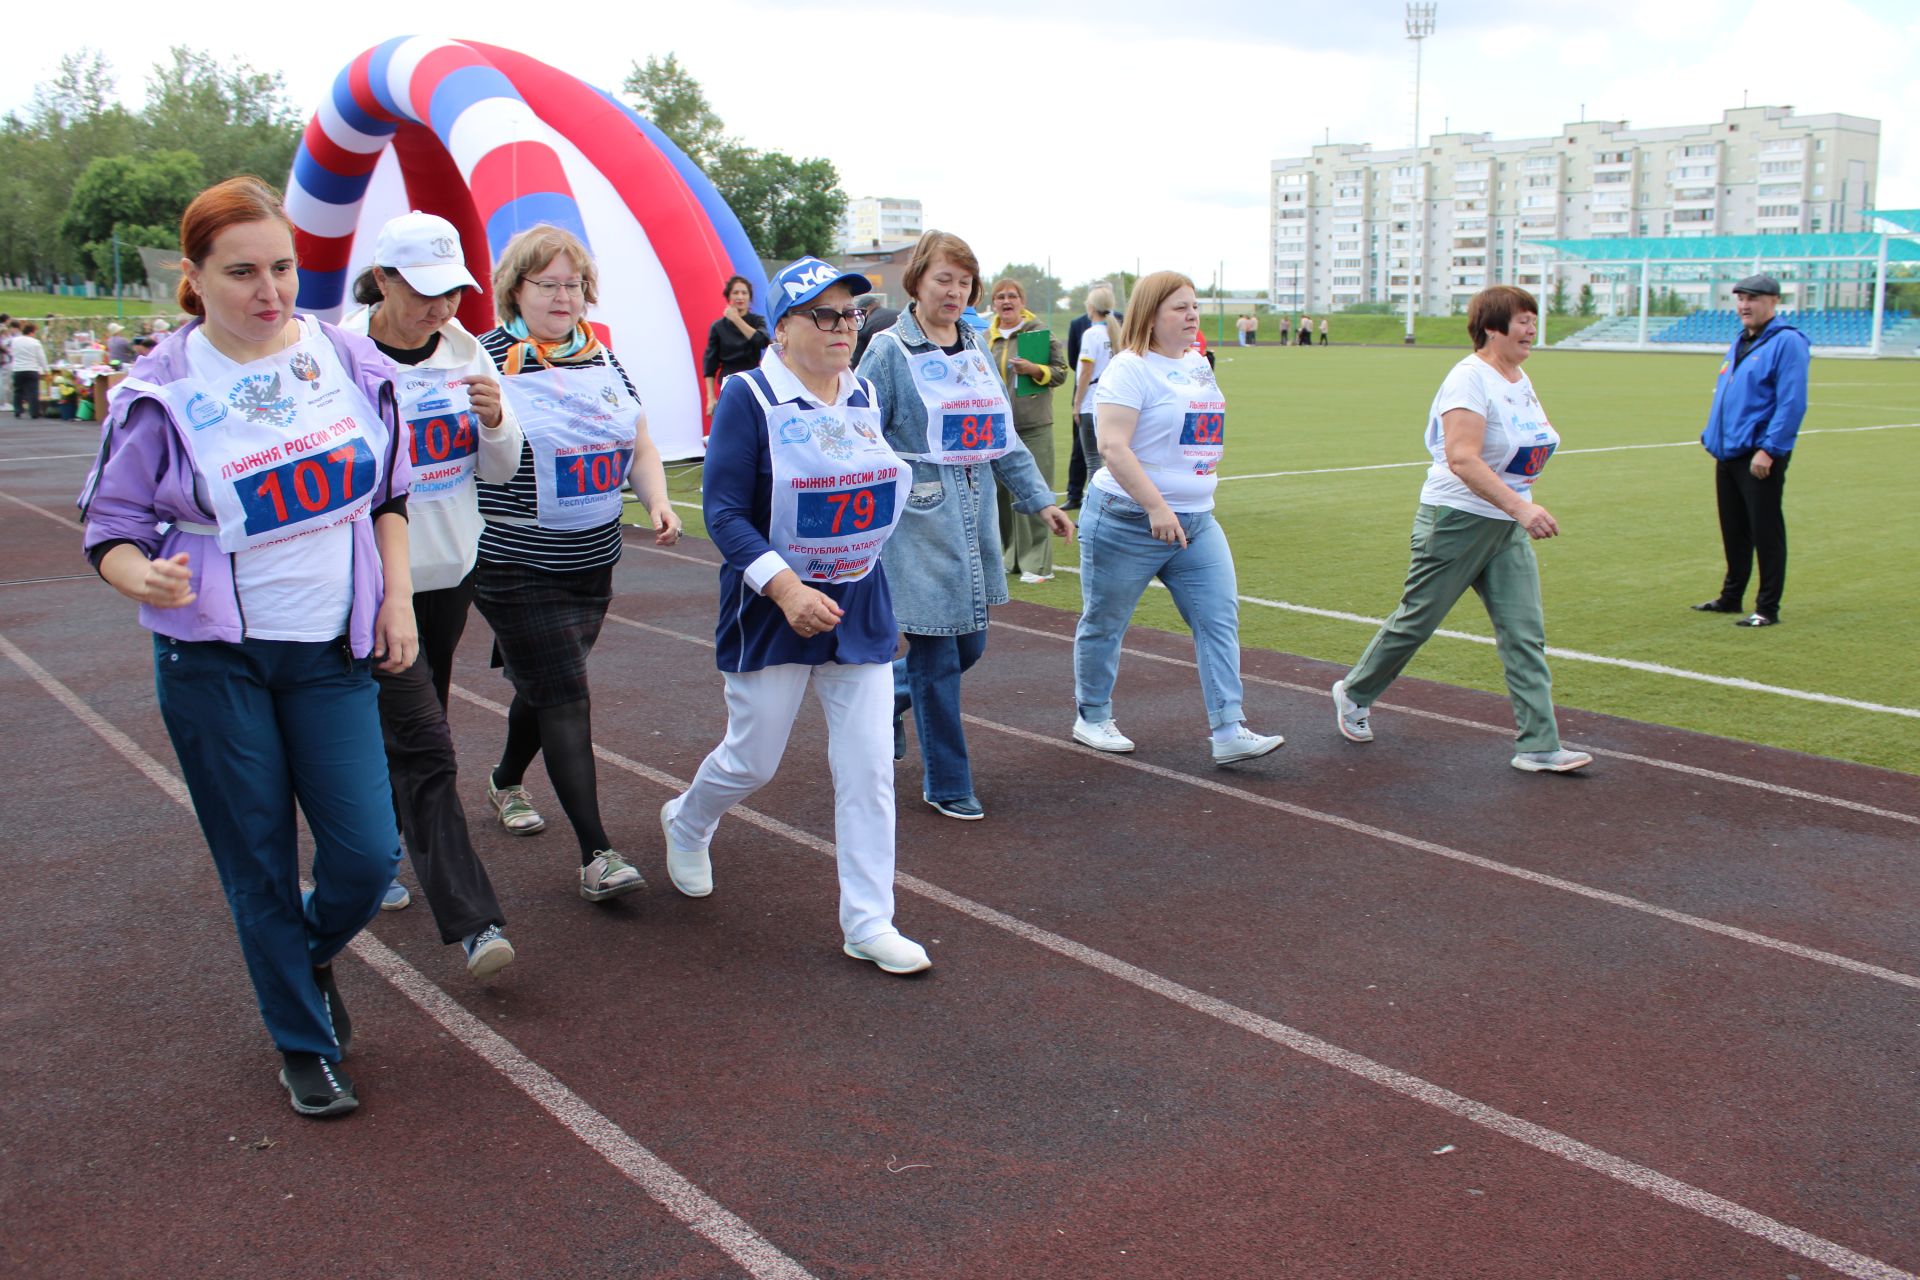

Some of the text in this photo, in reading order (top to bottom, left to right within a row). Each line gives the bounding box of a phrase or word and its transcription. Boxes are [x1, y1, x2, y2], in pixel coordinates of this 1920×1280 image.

[228, 374, 271, 401] ЛЫЖНЯ
[941, 399, 970, 410] ЛЫЖНЯ
[407, 413, 474, 465] 104
[961, 415, 995, 449] 84
[1194, 414, 1223, 443] 82
[221, 416, 357, 480] ЛЫЖНЯ РОССИИ 2010
[257, 445, 356, 523] 107
[413, 480, 454, 493] ЛЫЖНЯ
[421, 465, 462, 481] ЗАИНСК
[568, 451, 623, 494] 103
[791, 466, 898, 489] ЛЫЖНЯ РОССИИ 2010
[559, 494, 609, 508] Республика
[827, 489, 876, 534] 79
[788, 543, 849, 555] РЕСПУБЛИКА
